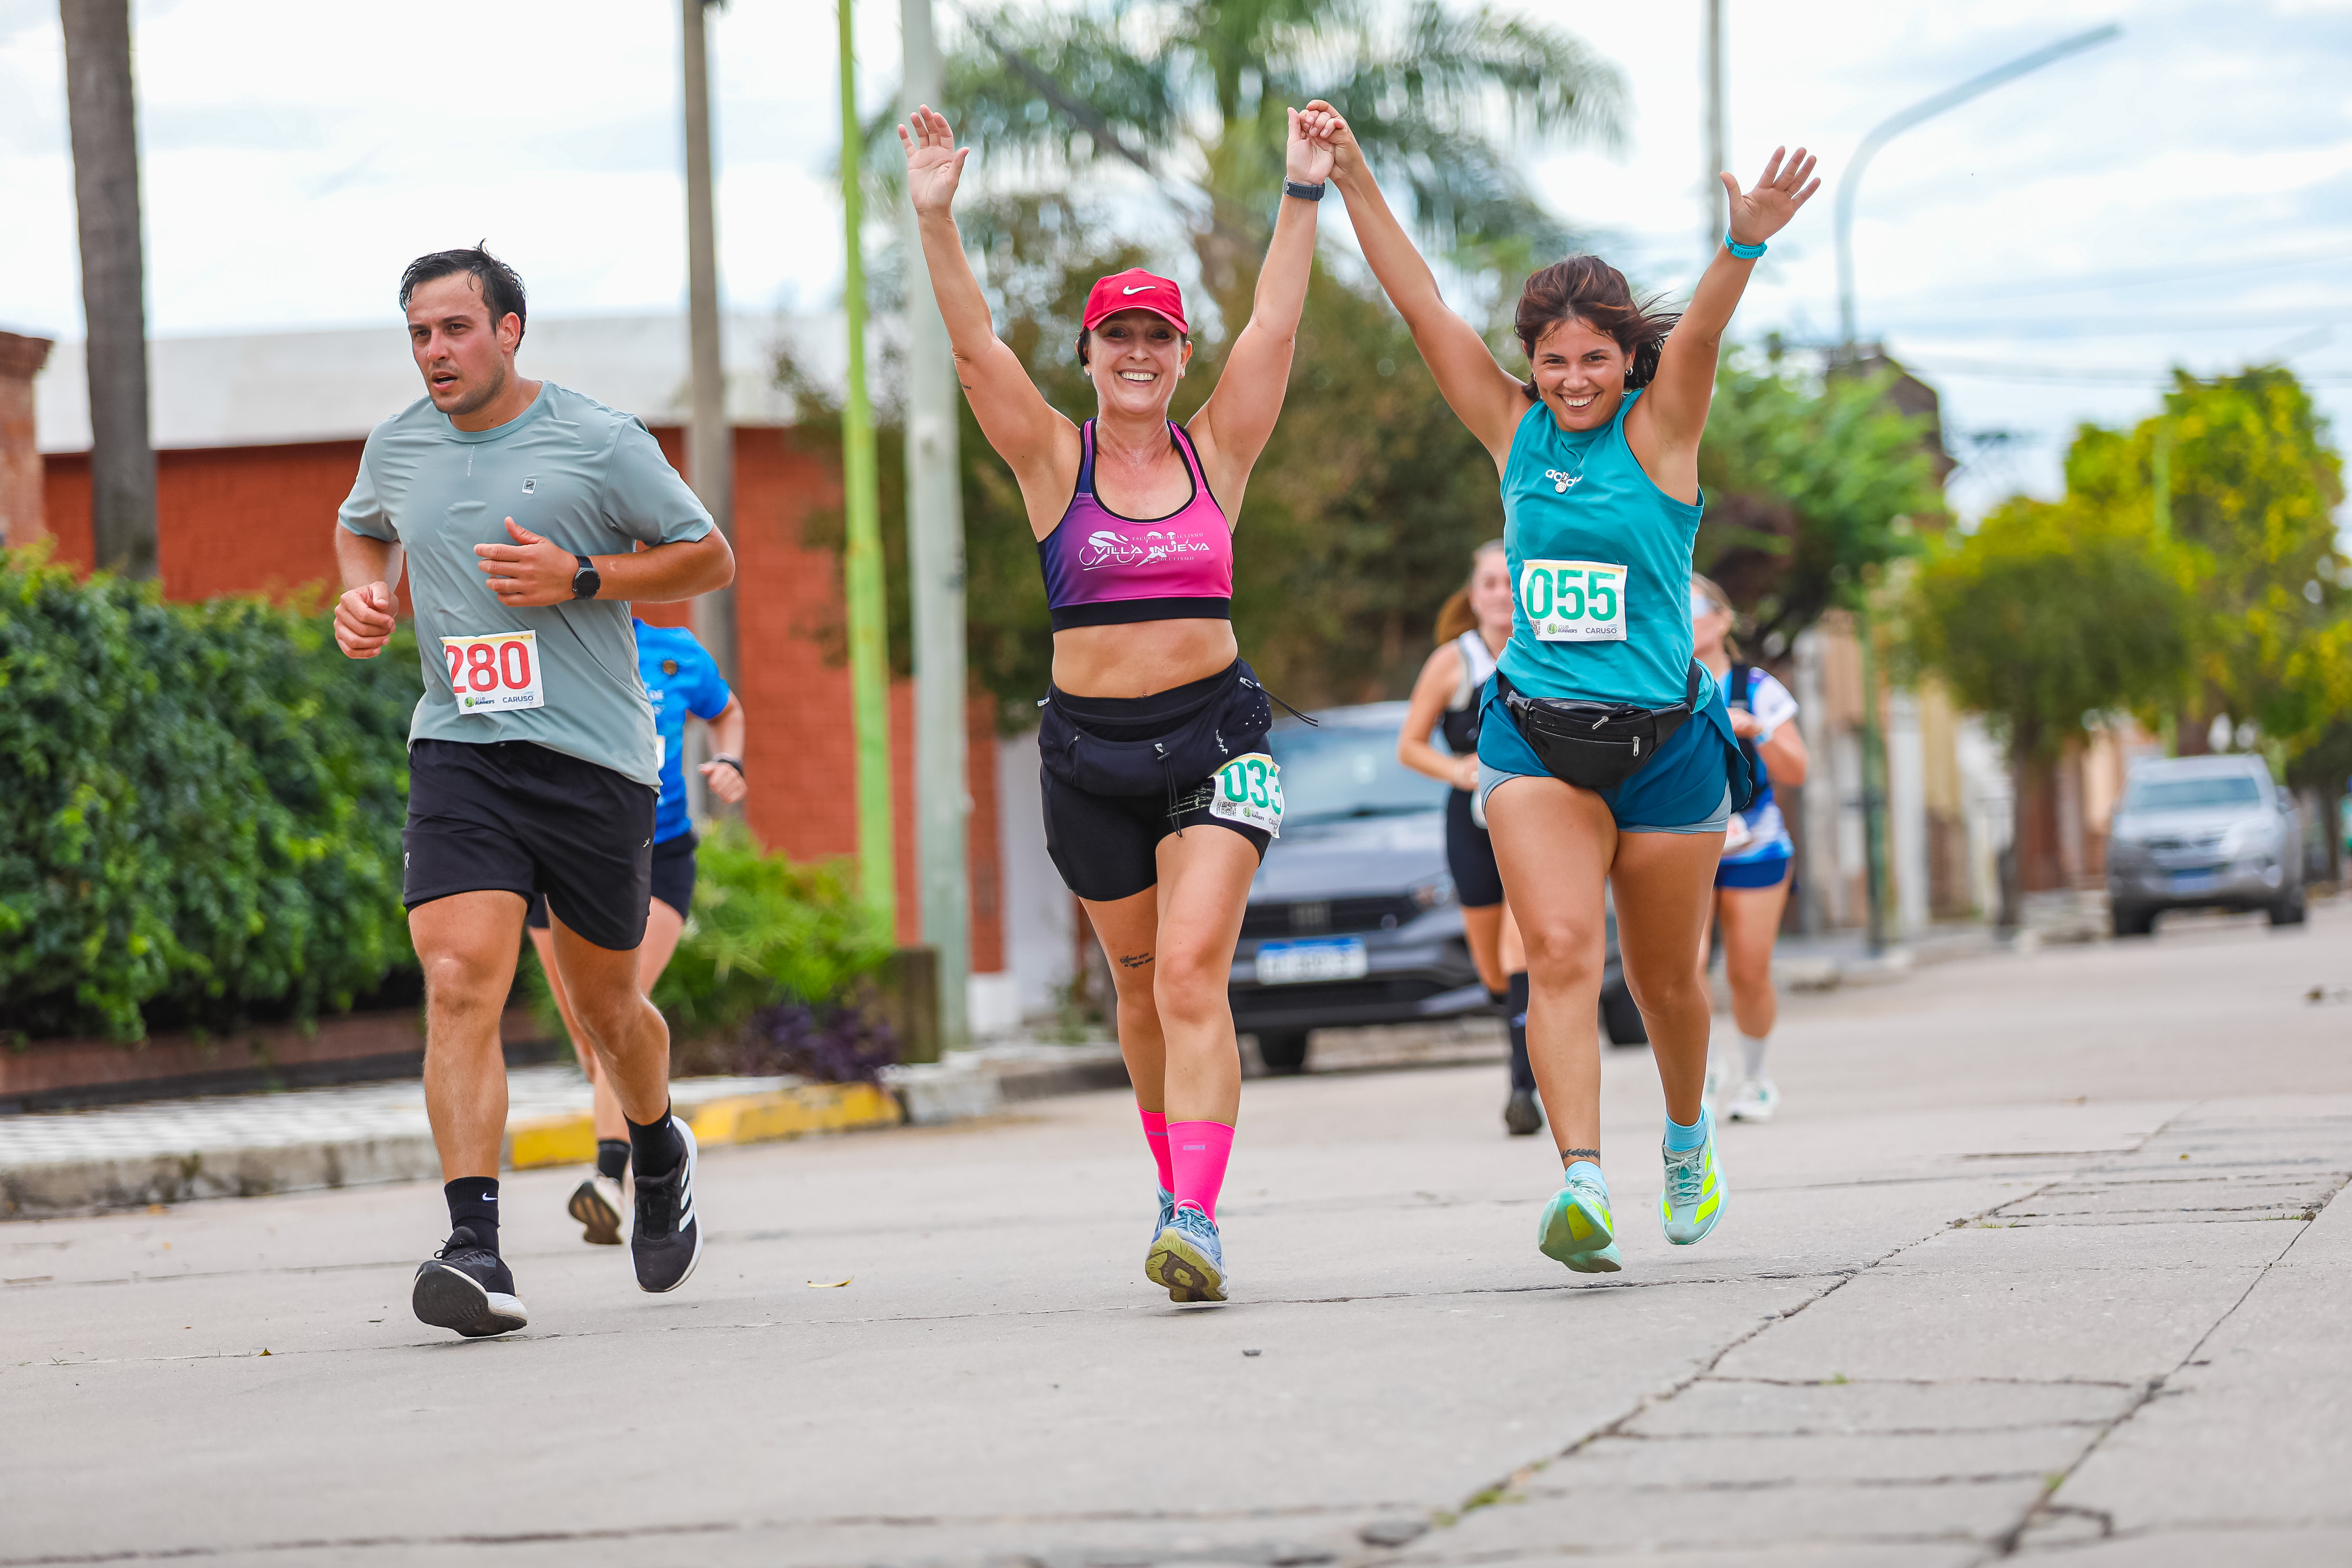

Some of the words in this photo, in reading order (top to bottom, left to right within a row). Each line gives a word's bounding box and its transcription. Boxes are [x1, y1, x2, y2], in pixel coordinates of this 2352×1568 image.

[1093, 546, 1144, 555] VILLA
[1154, 543, 1210, 553] NUEVA
[1526, 568, 1617, 621] 055
[445, 641, 531, 693] 280
